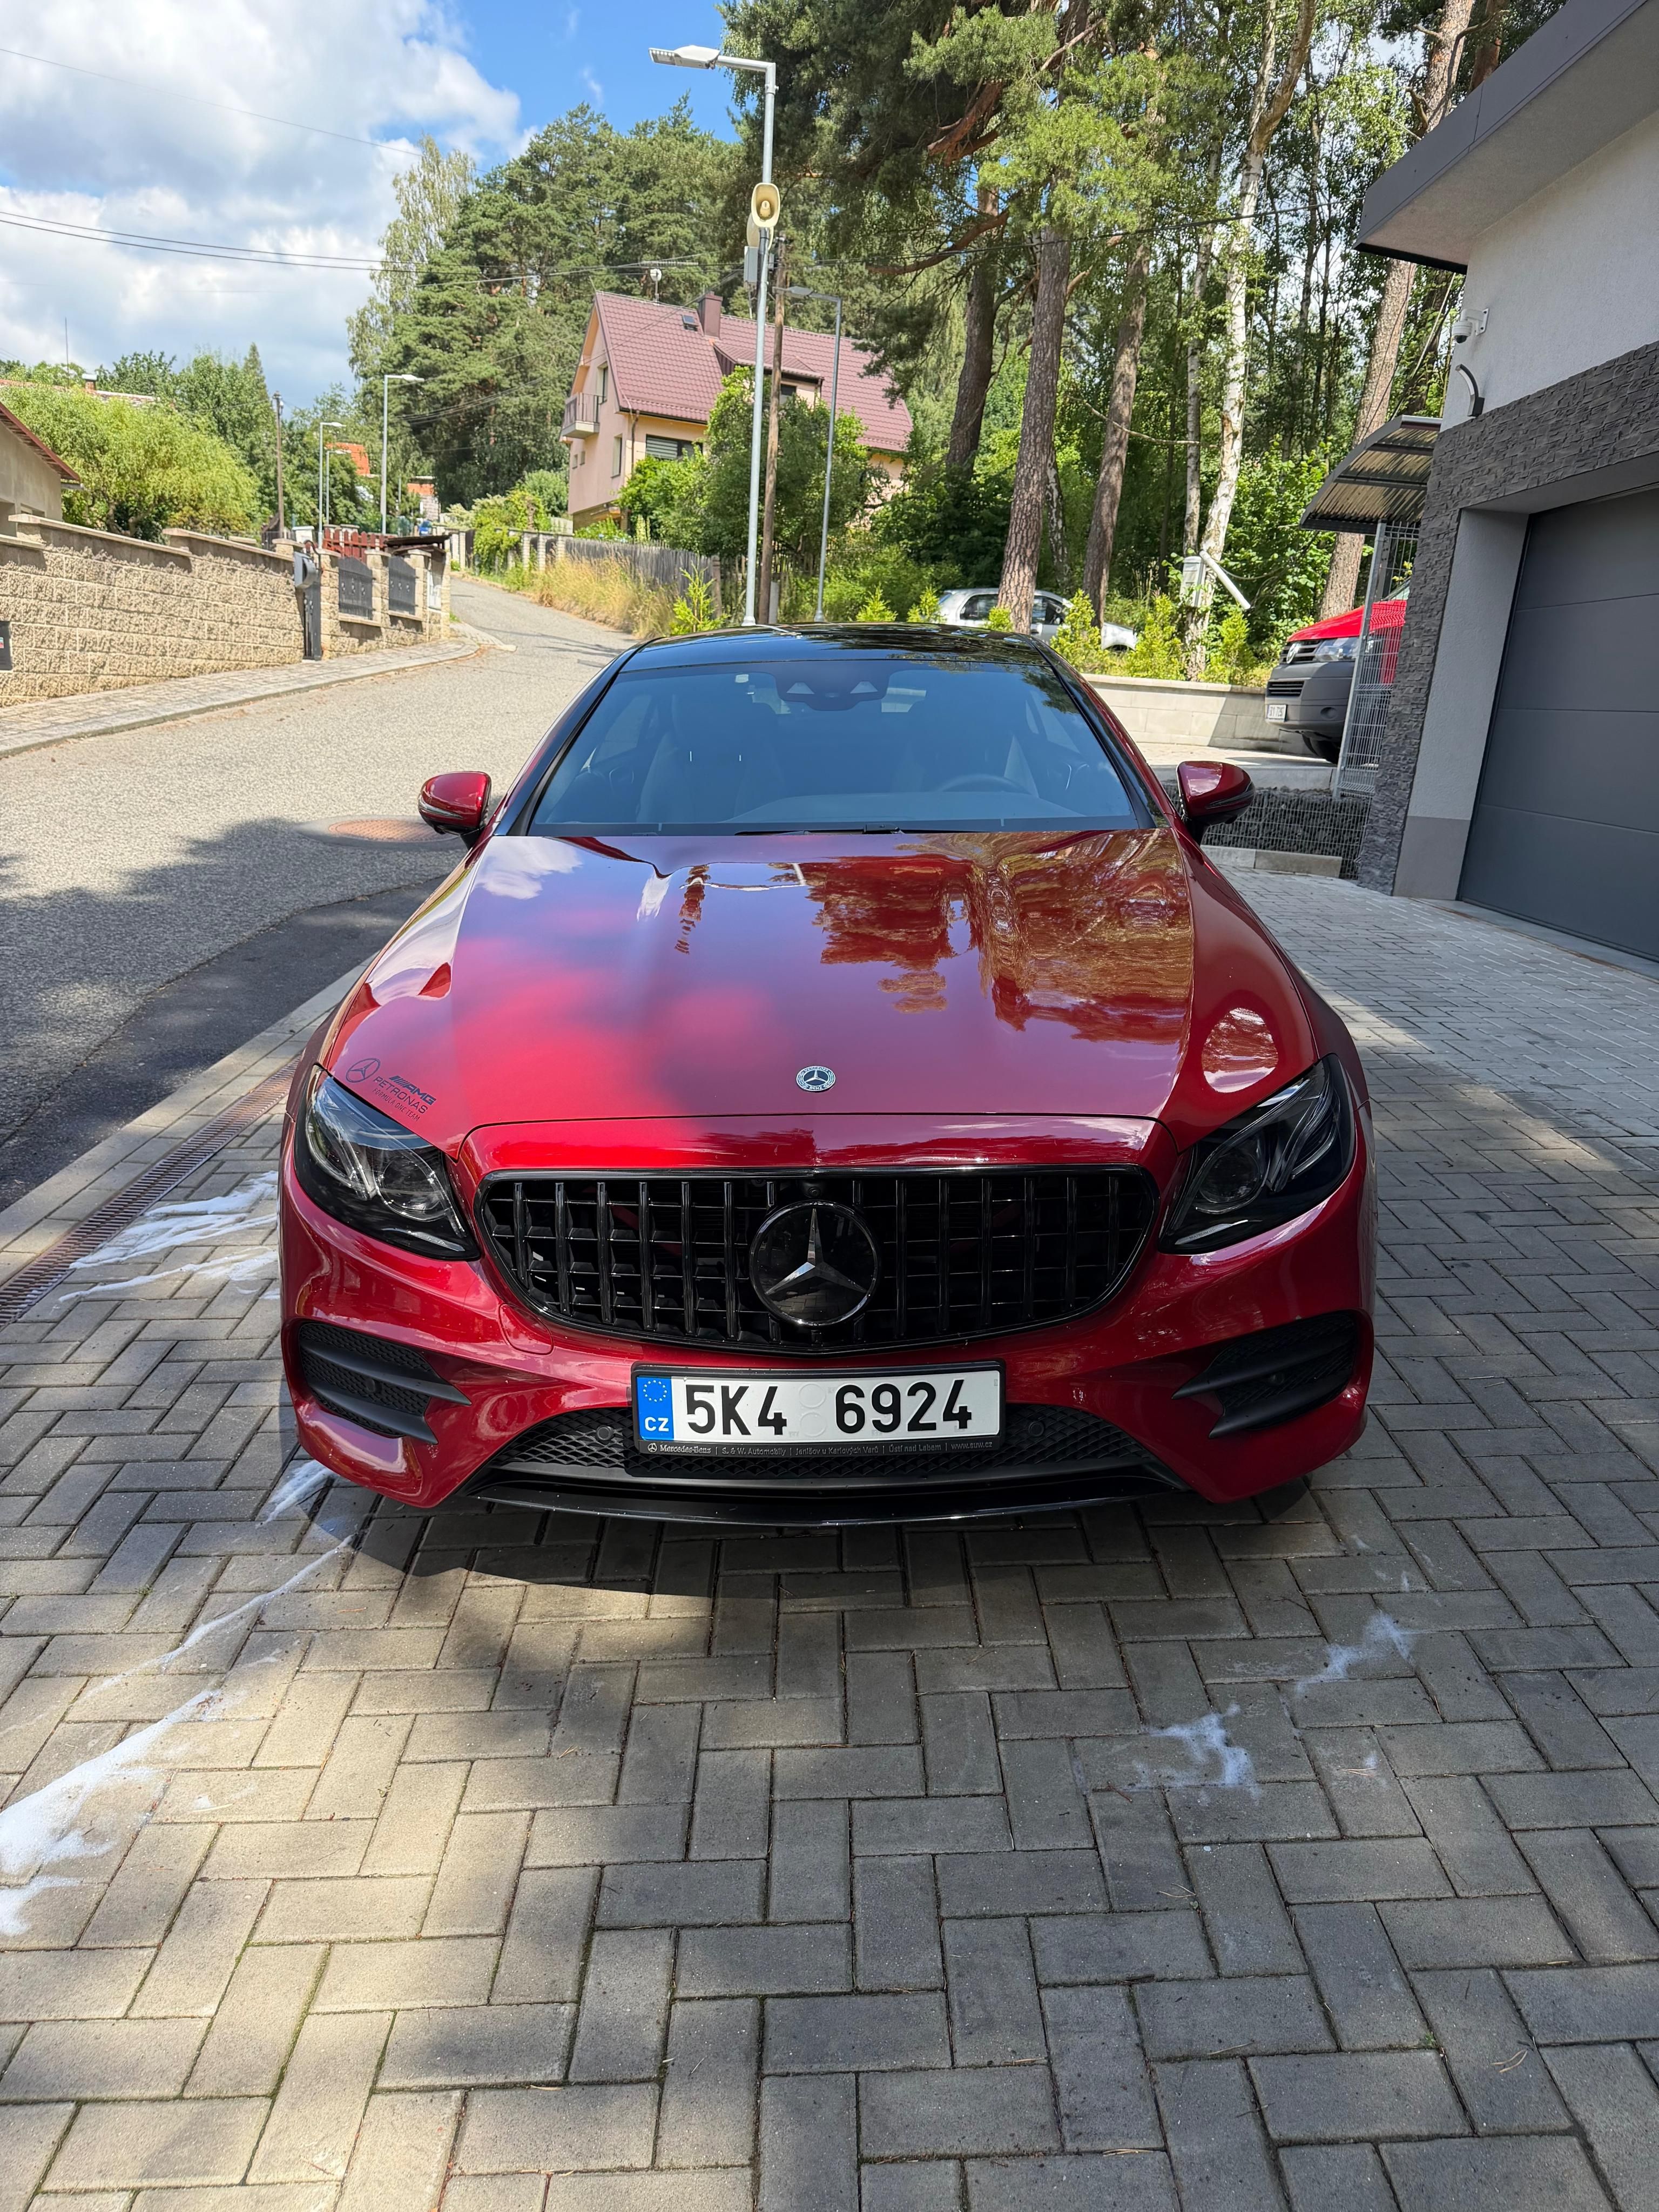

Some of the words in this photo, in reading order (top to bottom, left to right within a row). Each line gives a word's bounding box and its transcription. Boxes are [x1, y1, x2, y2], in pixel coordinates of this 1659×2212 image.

[373, 1076, 428, 1114] PETRONAS
[373, 1088, 395, 1105] FORMULA
[394, 1102, 406, 1112] ONE
[406, 1109, 421, 1122] TEAM
[403, 1082, 437, 1106] AMG
[685, 1384, 787, 1436] 5K4
[835, 1379, 972, 1434] 6924
[644, 1417, 669, 1432] CZ
[659, 1444, 712, 1454] Mercedes-Benz
[748, 1447, 786, 1456] Automobily
[828, 1447, 861, 1455] Karlových
[919, 1444, 941, 1452] Labem
